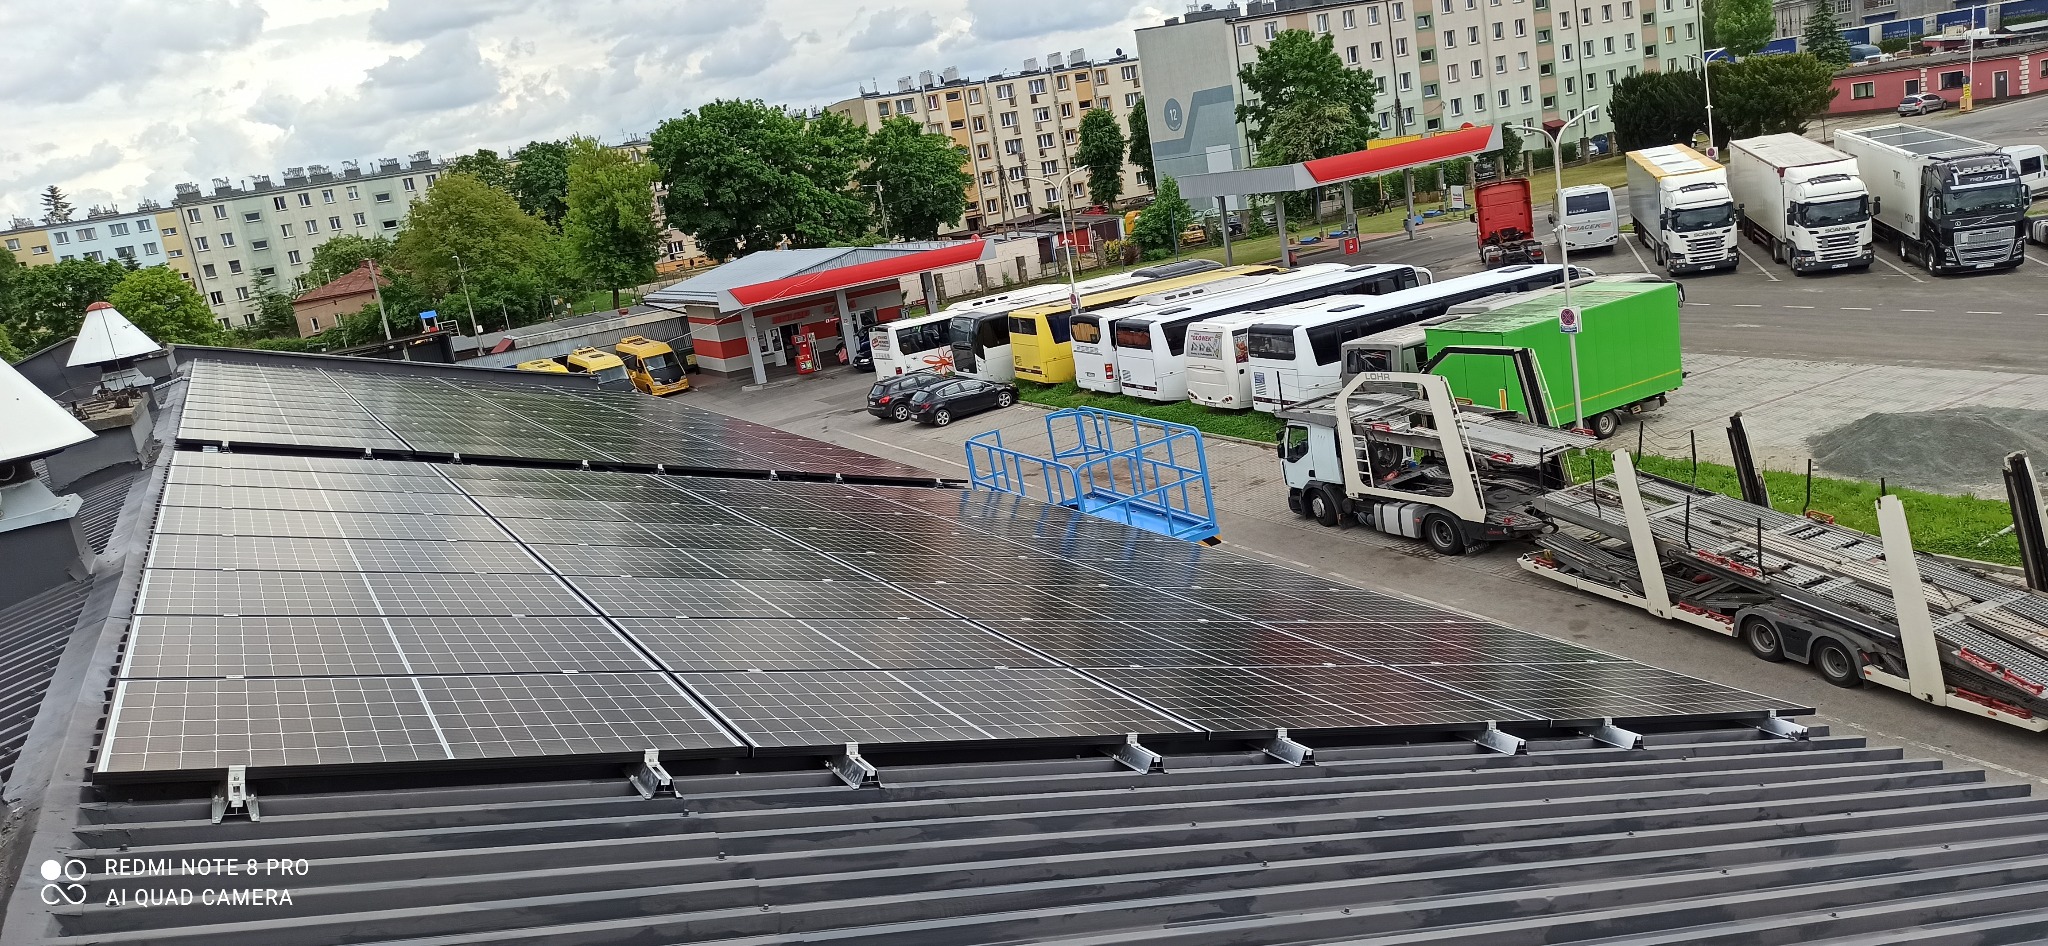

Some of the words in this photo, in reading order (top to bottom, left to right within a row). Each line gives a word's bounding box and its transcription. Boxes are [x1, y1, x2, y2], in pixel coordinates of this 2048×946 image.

[1169, 108, 1178, 121] 12
[1576, 223, 1601, 232] JACEK
[1824, 226, 1851, 234] SCANIA
[1364, 373, 1390, 381] LOHR
